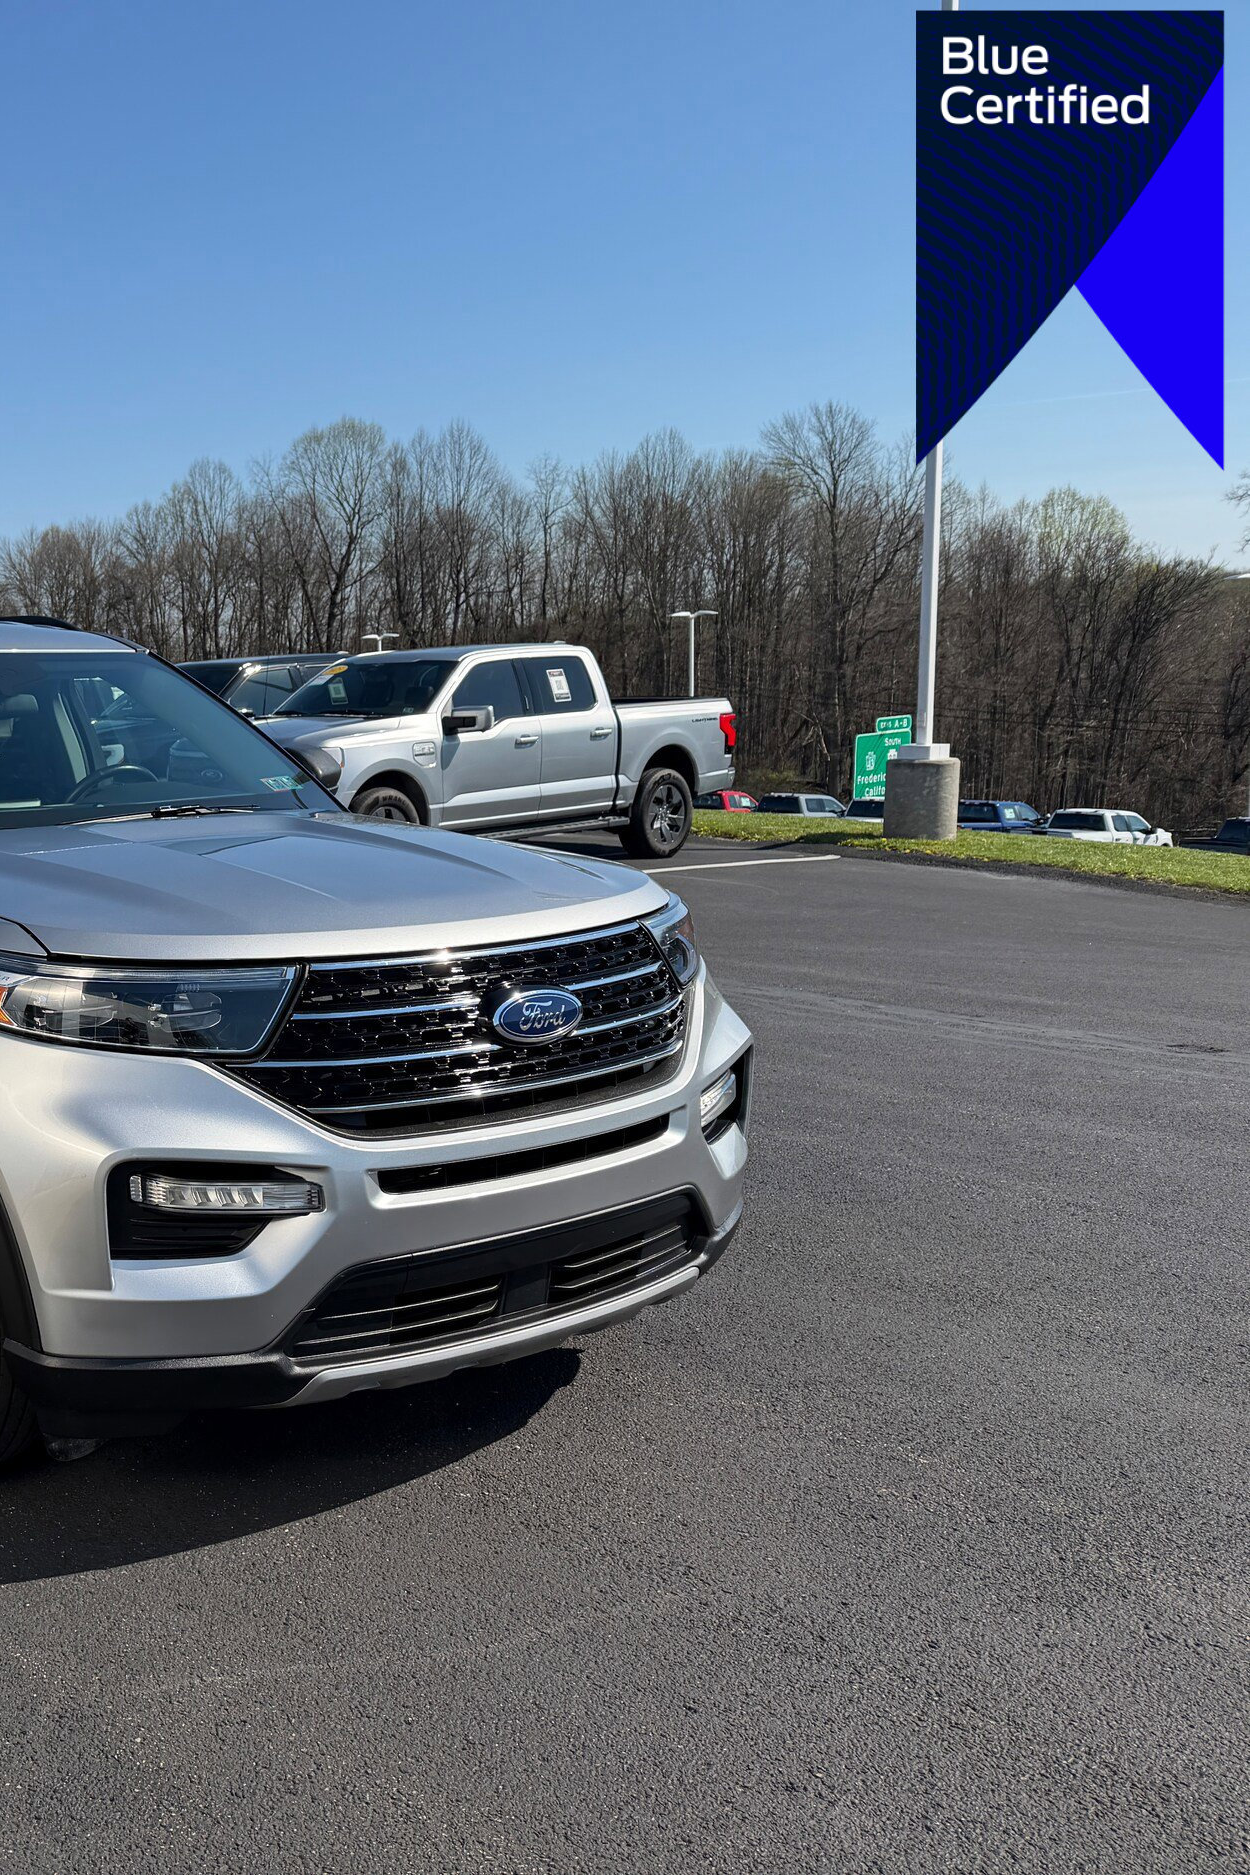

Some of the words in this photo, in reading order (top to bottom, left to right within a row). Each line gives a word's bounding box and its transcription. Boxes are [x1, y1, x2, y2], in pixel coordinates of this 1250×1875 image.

[857, 772, 886, 784] Frederic
[864, 786, 886, 796] Califo
[518, 1000, 566, 1031] Ford
